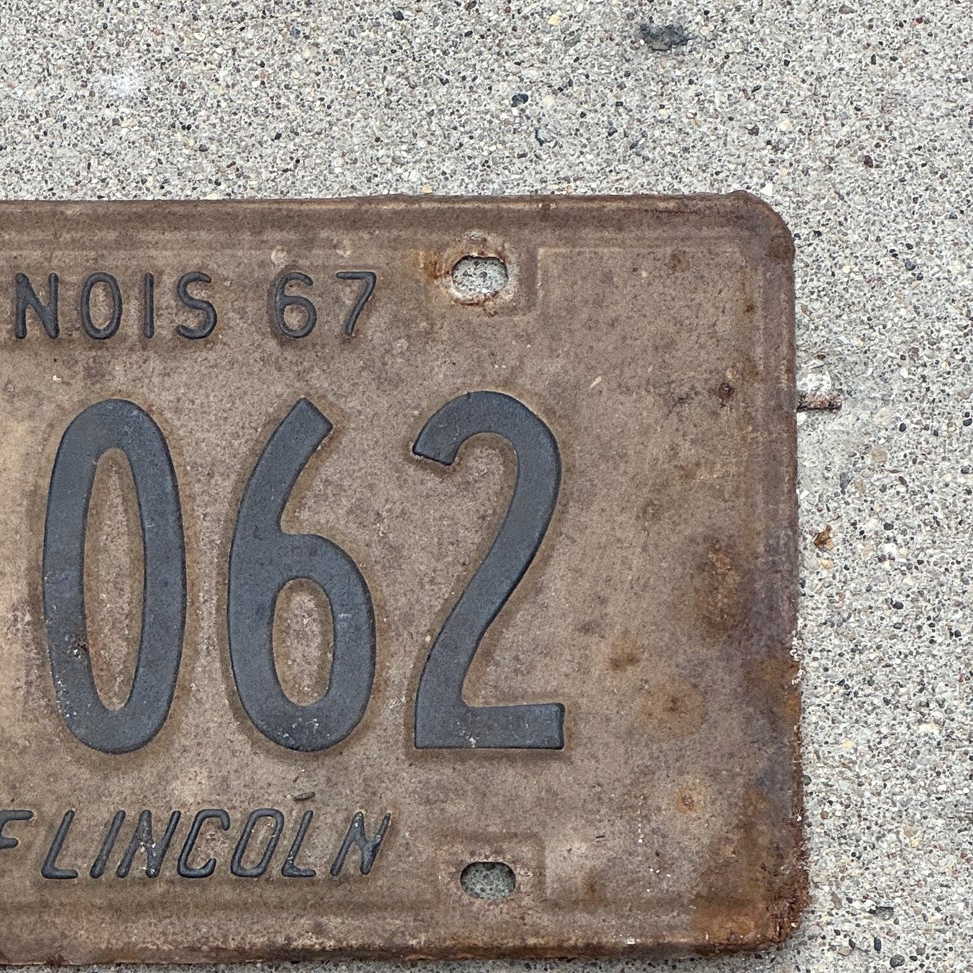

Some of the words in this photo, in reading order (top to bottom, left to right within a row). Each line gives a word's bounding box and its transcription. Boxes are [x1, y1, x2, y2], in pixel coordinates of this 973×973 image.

[276, 271, 377, 338] 67
[42, 391, 565, 754] 062
[41, 809, 391, 879] LINCOLN
